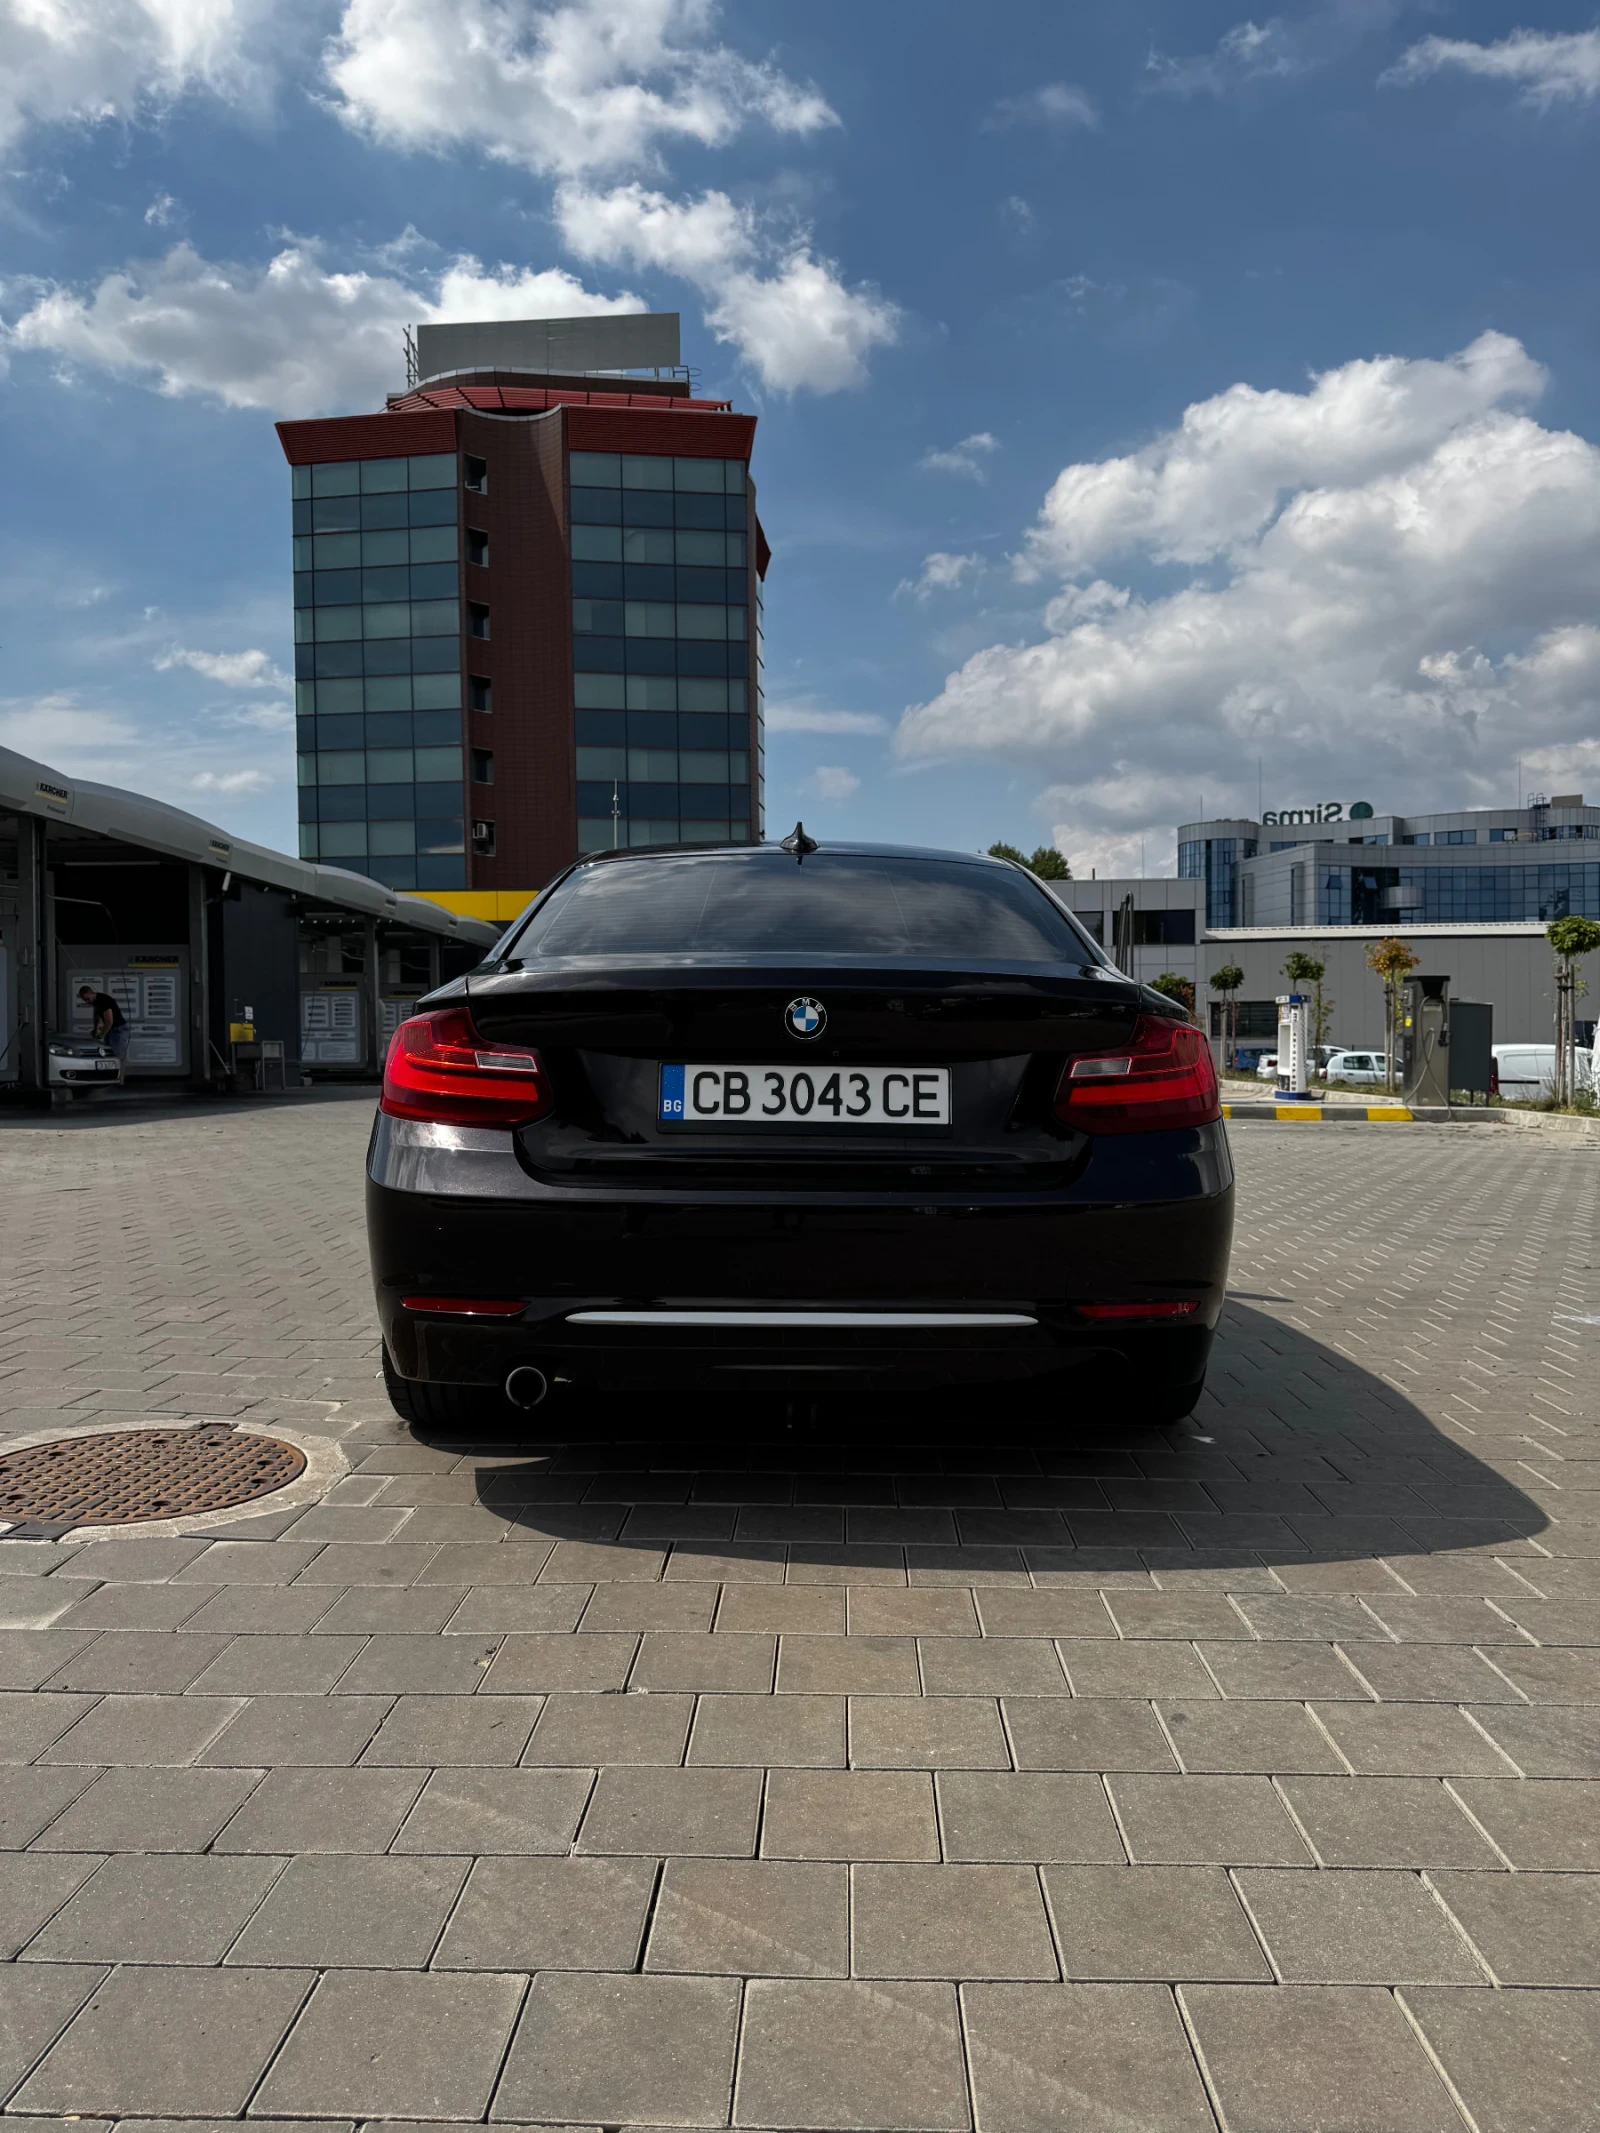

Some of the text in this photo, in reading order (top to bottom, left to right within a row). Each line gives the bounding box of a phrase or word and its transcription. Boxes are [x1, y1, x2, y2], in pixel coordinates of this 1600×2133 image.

[788, 998, 824, 1012] BMW
[693, 1071, 941, 1118] CB 3043 CE
[663, 1100, 682, 1113] BG
